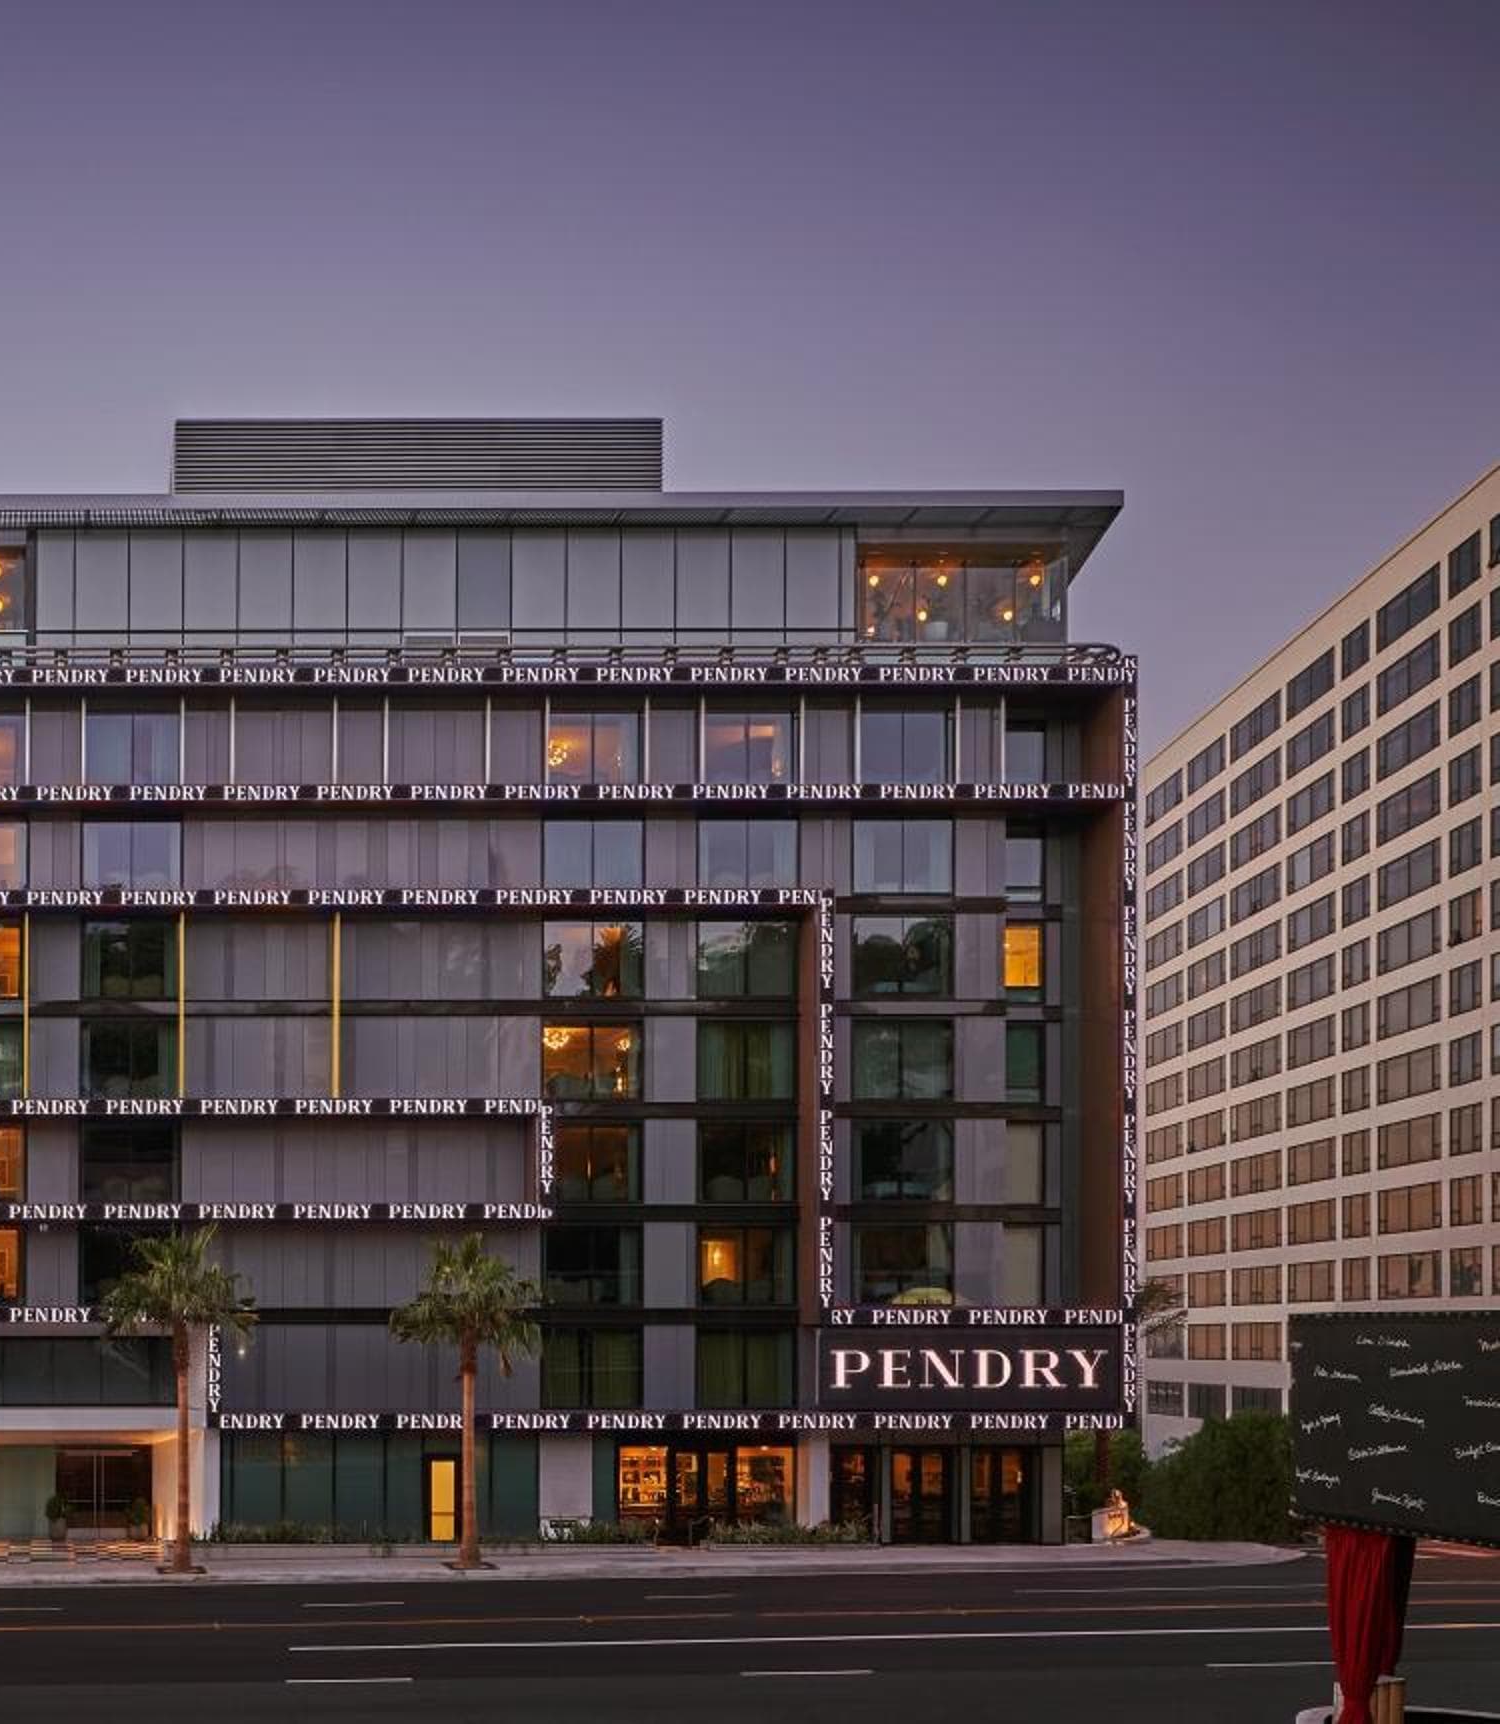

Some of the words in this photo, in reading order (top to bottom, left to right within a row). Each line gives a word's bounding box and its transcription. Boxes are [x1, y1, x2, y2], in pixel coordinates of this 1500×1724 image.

[32, 669, 106, 684] PENDRY
[126, 669, 200, 683] PENDRY
[220, 668, 294, 683] PENDRY
[314, 668, 388, 682] PENDRY
[408, 668, 483, 682] PENDRY
[502, 668, 578, 682] PENDRY
[597, 668, 672, 682] PENDRY
[692, 667, 766, 682] PENDRY
[786, 667, 860, 682] PENDRY
[880, 667, 954, 682] PENDRY
[974, 667, 1048, 681] PENDRY
[1124, 698, 1137, 787] PENDRY
[37, 786, 112, 800] PENDRY
[130, 786, 204, 800] PENDRY
[224, 786, 298, 800] PENDRY
[317, 786, 392, 800] PENDRY
[411, 785, 486, 800] PENDRY
[505, 785, 580, 799] PENDRY
[599, 784, 674, 799] PENDRY
[693, 784, 768, 799] PENDRY
[787, 784, 861, 799] PENDRY
[881, 784, 956, 799] PENDRY
[975, 784, 1049, 799] PENDRY
[1124, 802, 1137, 891] PENDRY
[27, 890, 103, 905] PENDRY
[121, 890, 196, 905] PENDRY
[215, 890, 290, 904] PENDRY
[308, 890, 384, 904] PENDRY
[402, 890, 478, 904] PENDRY
[497, 890, 572, 904] PENDRY
[590, 890, 666, 904] PENDRY
[684, 890, 760, 904] PENDRY
[779, 889, 821, 905] PEN
[819, 897, 833, 989] PENDRY
[1124, 905, 1137, 995] PENDRY
[819, 1003, 833, 1095] PENDRY
[1124, 1009, 1137, 1099] PENDRY
[12, 1100, 88, 1114] PENDRY
[106, 1100, 183, 1114] PENDRY
[201, 1100, 277, 1114] PENDRY
[296, 1099, 372, 1114] PENDRY
[390, 1099, 466, 1114] PENDRY
[541, 1105, 554, 1194] PENDRY
[819, 1110, 833, 1201] PENDRY
[1124, 1115, 1137, 1203] PENDRY
[10, 1204, 86, 1219] PENDRY
[105, 1204, 180, 1219] PENDRY
[199, 1204, 276, 1218] PENDRY
[294, 1204, 370, 1219] PENDRY
[390, 1204, 466, 1218] PENDRY
[819, 1217, 833, 1308] PENDRY
[1124, 1219, 1137, 1308] PENDRY
[10, 1308, 90, 1323] PENDRY
[873, 1310, 950, 1324] PENDRY
[970, 1310, 1046, 1324] PENDRY
[208, 1324, 221, 1412] PENDRY
[830, 1349, 1109, 1389] PENDRY
[1124, 1323, 1137, 1413] PENDRY
[302, 1414, 378, 1429] PENDRY
[398, 1415, 464, 1429] PENDR
[493, 1414, 569, 1429] PENDRY
[588, 1414, 665, 1429] PENDRY
[684, 1415, 760, 1429] PENDRY
[780, 1414, 856, 1429] PENDRY
[875, 1415, 951, 1429] PENDRY
[972, 1415, 1047, 1429] PENDRY
